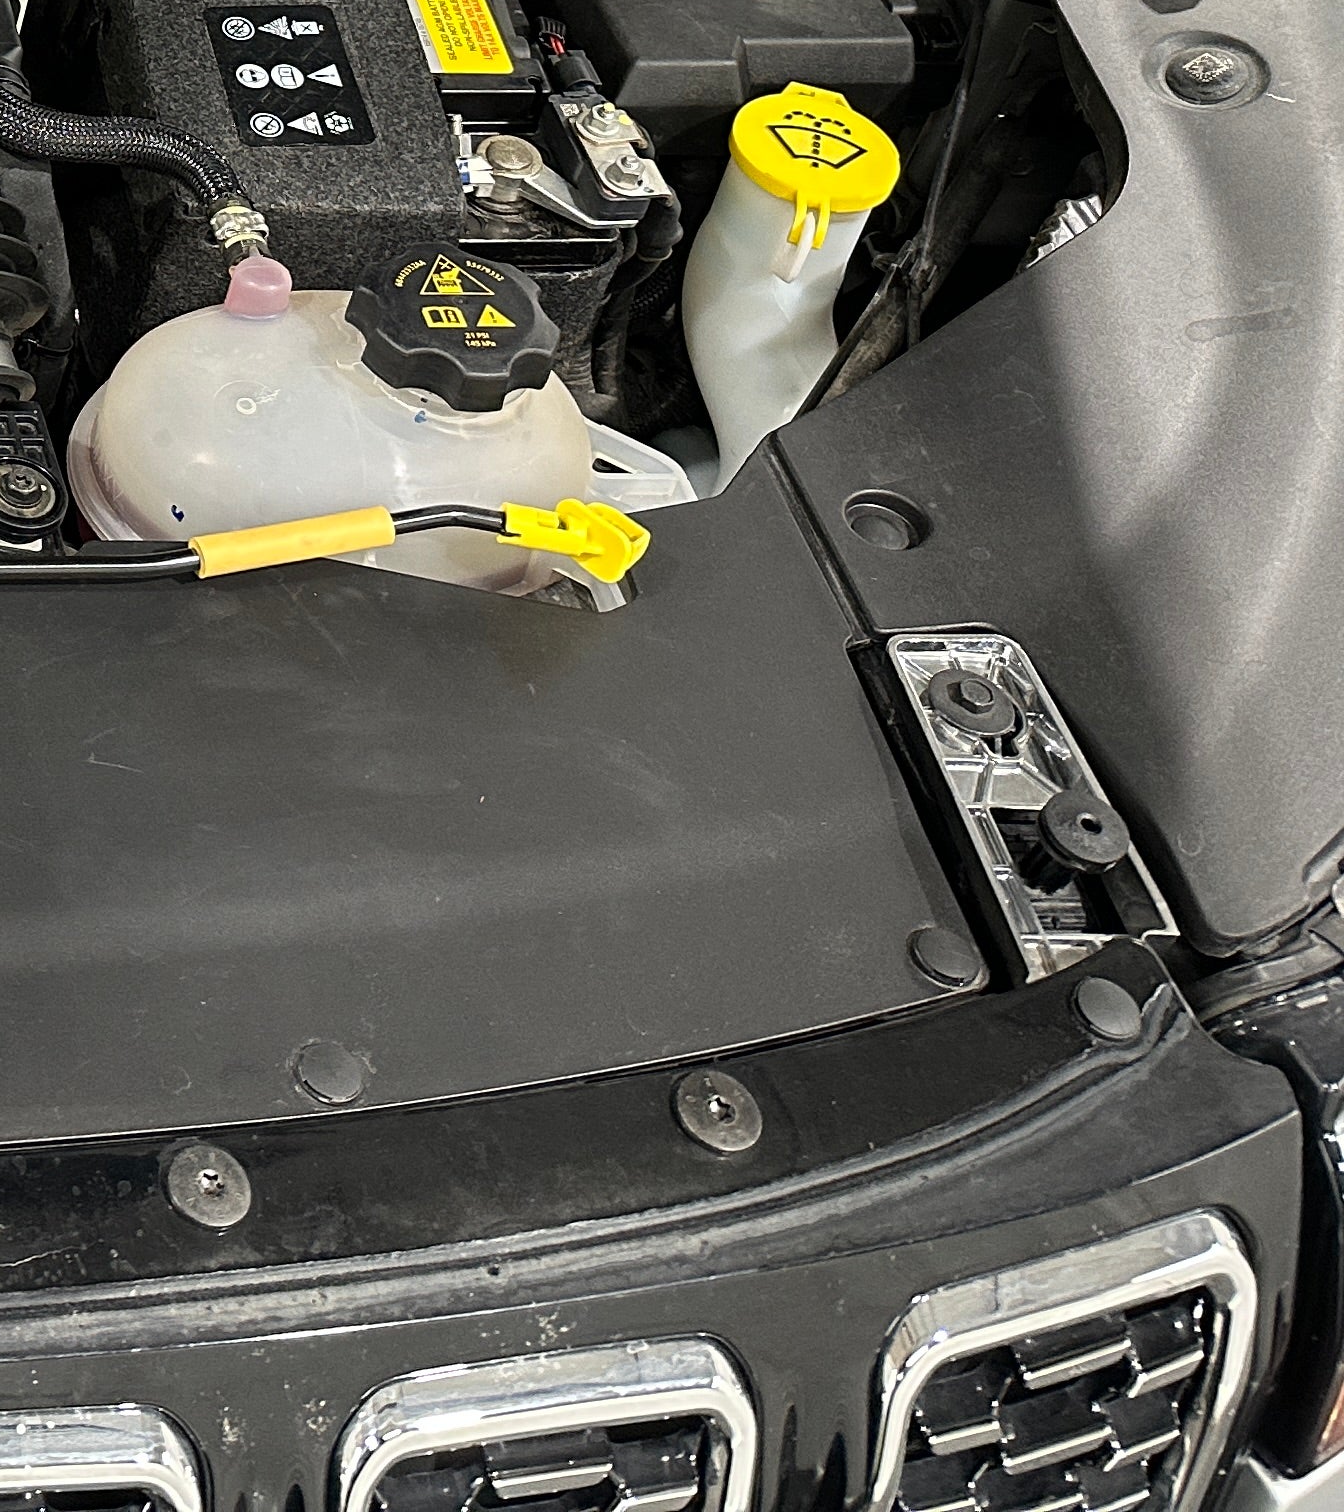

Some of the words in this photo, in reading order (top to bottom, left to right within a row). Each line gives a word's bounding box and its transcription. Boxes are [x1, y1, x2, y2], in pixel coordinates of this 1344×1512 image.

[447, 22, 458, 36] NOT
[440, 33, 458, 61] SEALED
[452, 36, 463, 48] DO
[464, 331, 476, 339] 21
